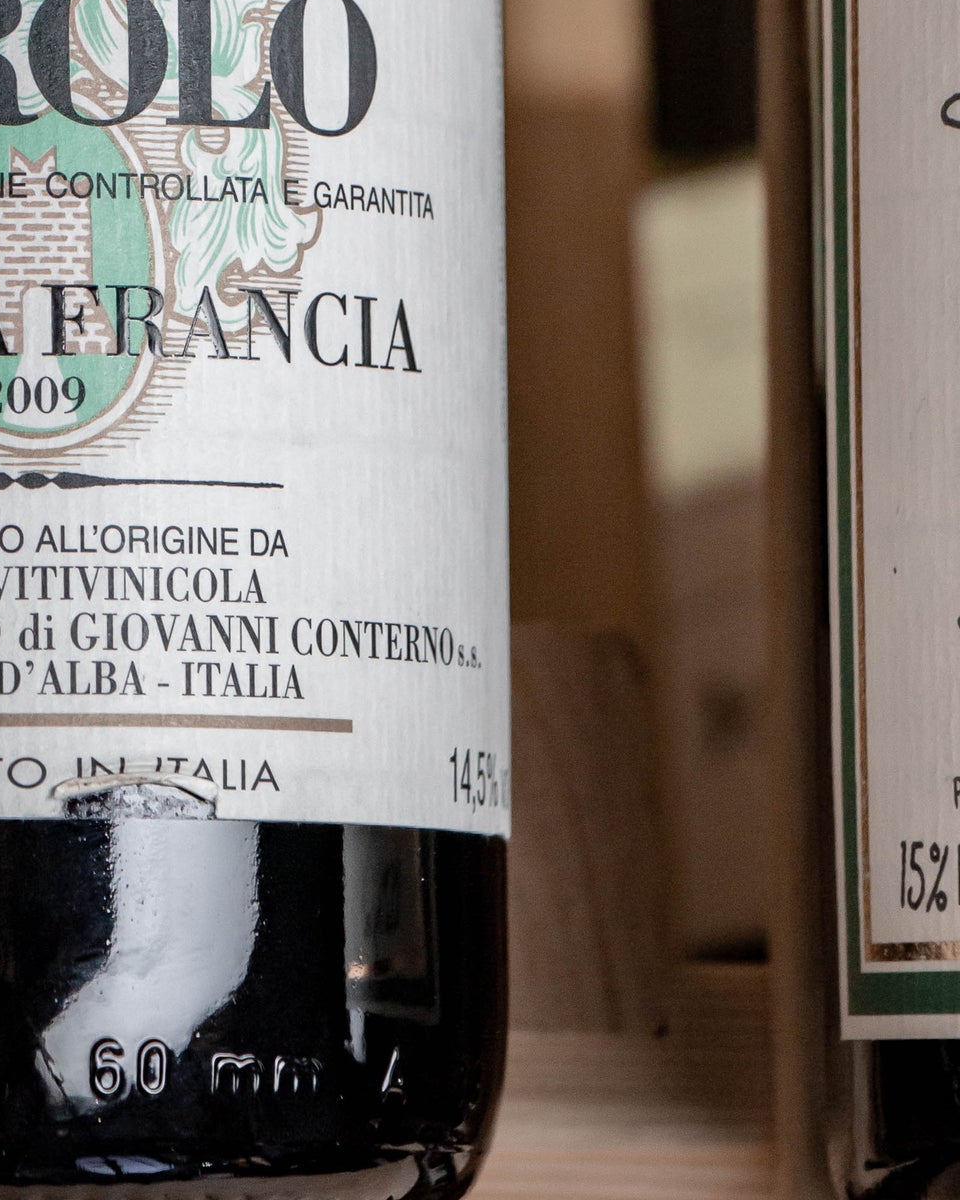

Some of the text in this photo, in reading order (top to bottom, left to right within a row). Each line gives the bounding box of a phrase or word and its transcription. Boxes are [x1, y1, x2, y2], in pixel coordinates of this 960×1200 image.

[45, 171, 267, 203] CONTROLLATA
[283, 179, 300, 205] E
[313, 181, 435, 220] GARANTITA
[40, 283, 422, 373] FRANCIA
[35, 524, 240, 556] ALL'ORIGINE
[249, 528, 289, 558] DA
[18, 613, 57, 651] di
[70, 611, 280, 655] GIOVANNI
[290, 617, 454, 666] CONTERNO
[457, 644, 482, 669] s.s.
[180, 661, 305, 700] ITALIA
[450, 747, 499, 814] 14,5%
[900, 840, 949, 913] 15%
[89, 1037, 170, 1100] 60
